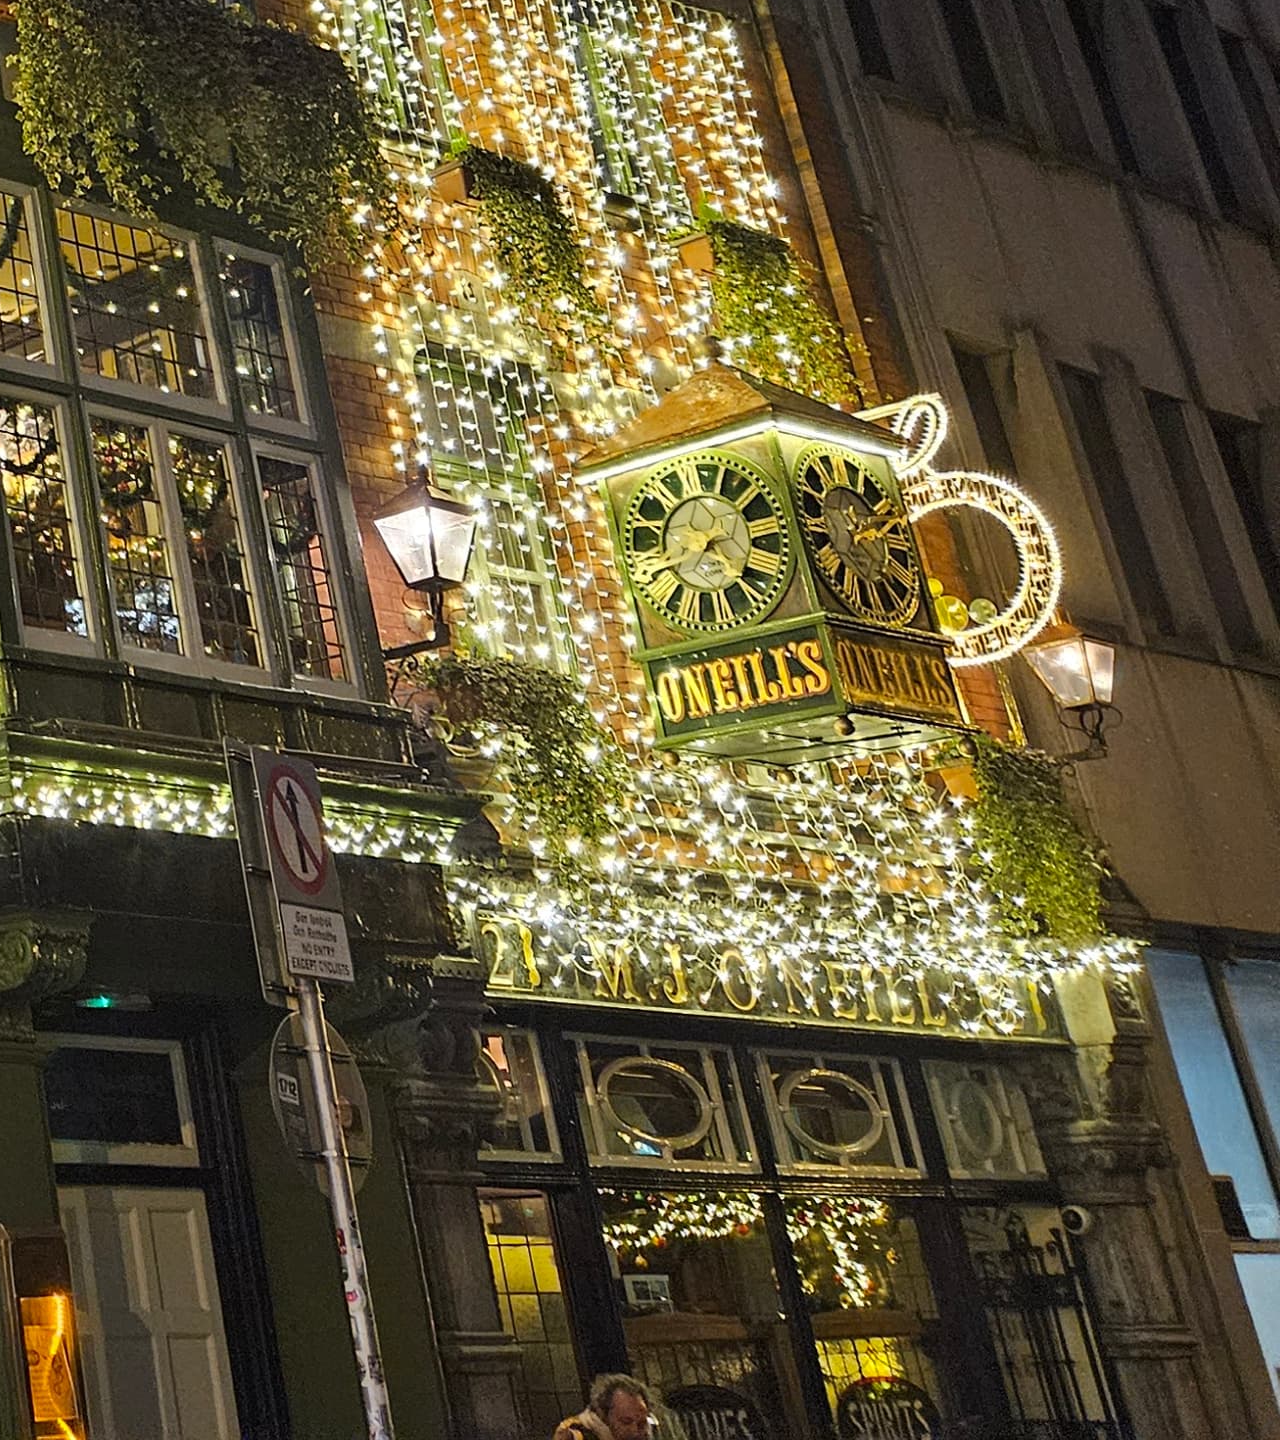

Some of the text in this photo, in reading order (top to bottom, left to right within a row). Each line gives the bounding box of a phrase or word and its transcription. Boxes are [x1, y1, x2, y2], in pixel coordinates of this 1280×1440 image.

[657, 640, 833, 724] ONEILL'S
[302, 943, 335, 958] NO ENTRY
[291, 956, 351, 976] EXCEPT CYCLISTS
